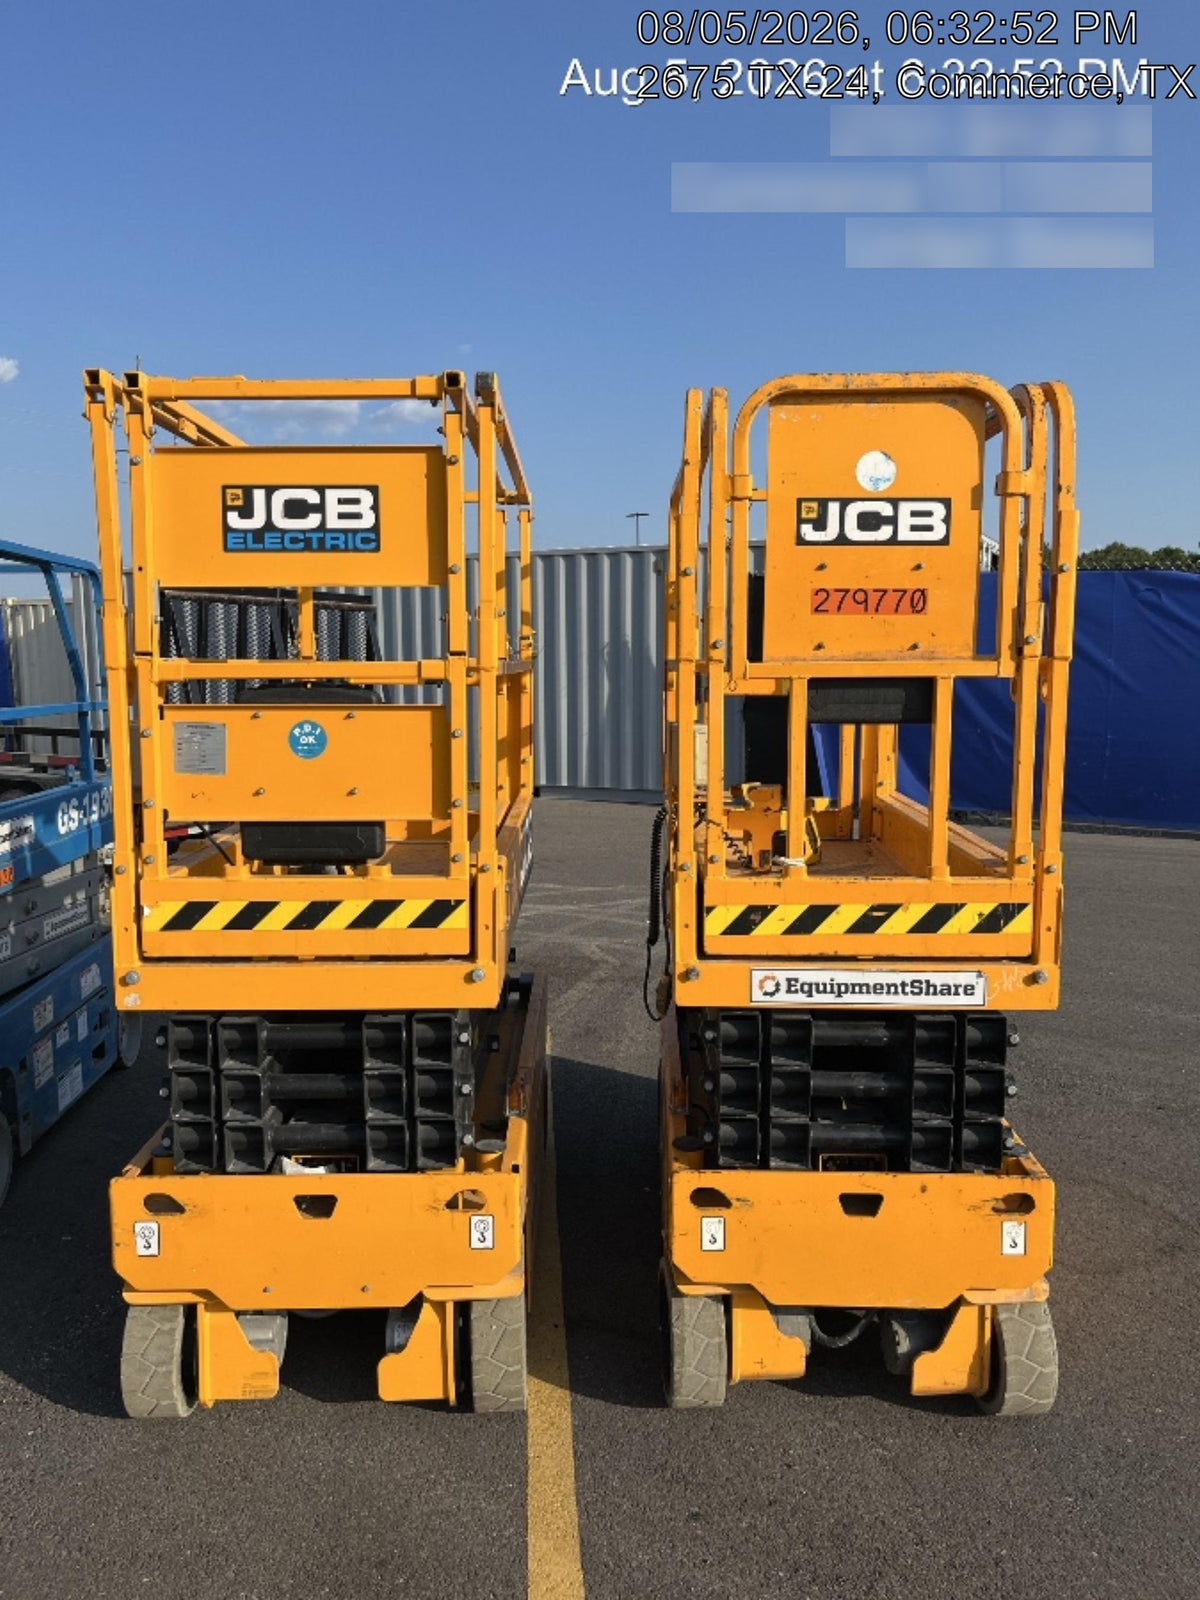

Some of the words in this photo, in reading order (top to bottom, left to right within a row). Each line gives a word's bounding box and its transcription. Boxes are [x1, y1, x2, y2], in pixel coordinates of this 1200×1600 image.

[226, 487, 377, 530] JCB
[800, 501, 947, 541] JCB
[226, 532, 377, 550] ELECTRIC
[813, 587, 927, 614] 279770
[300, 735, 317, 744] OK
[785, 977, 976, 999] EquipmentShare
